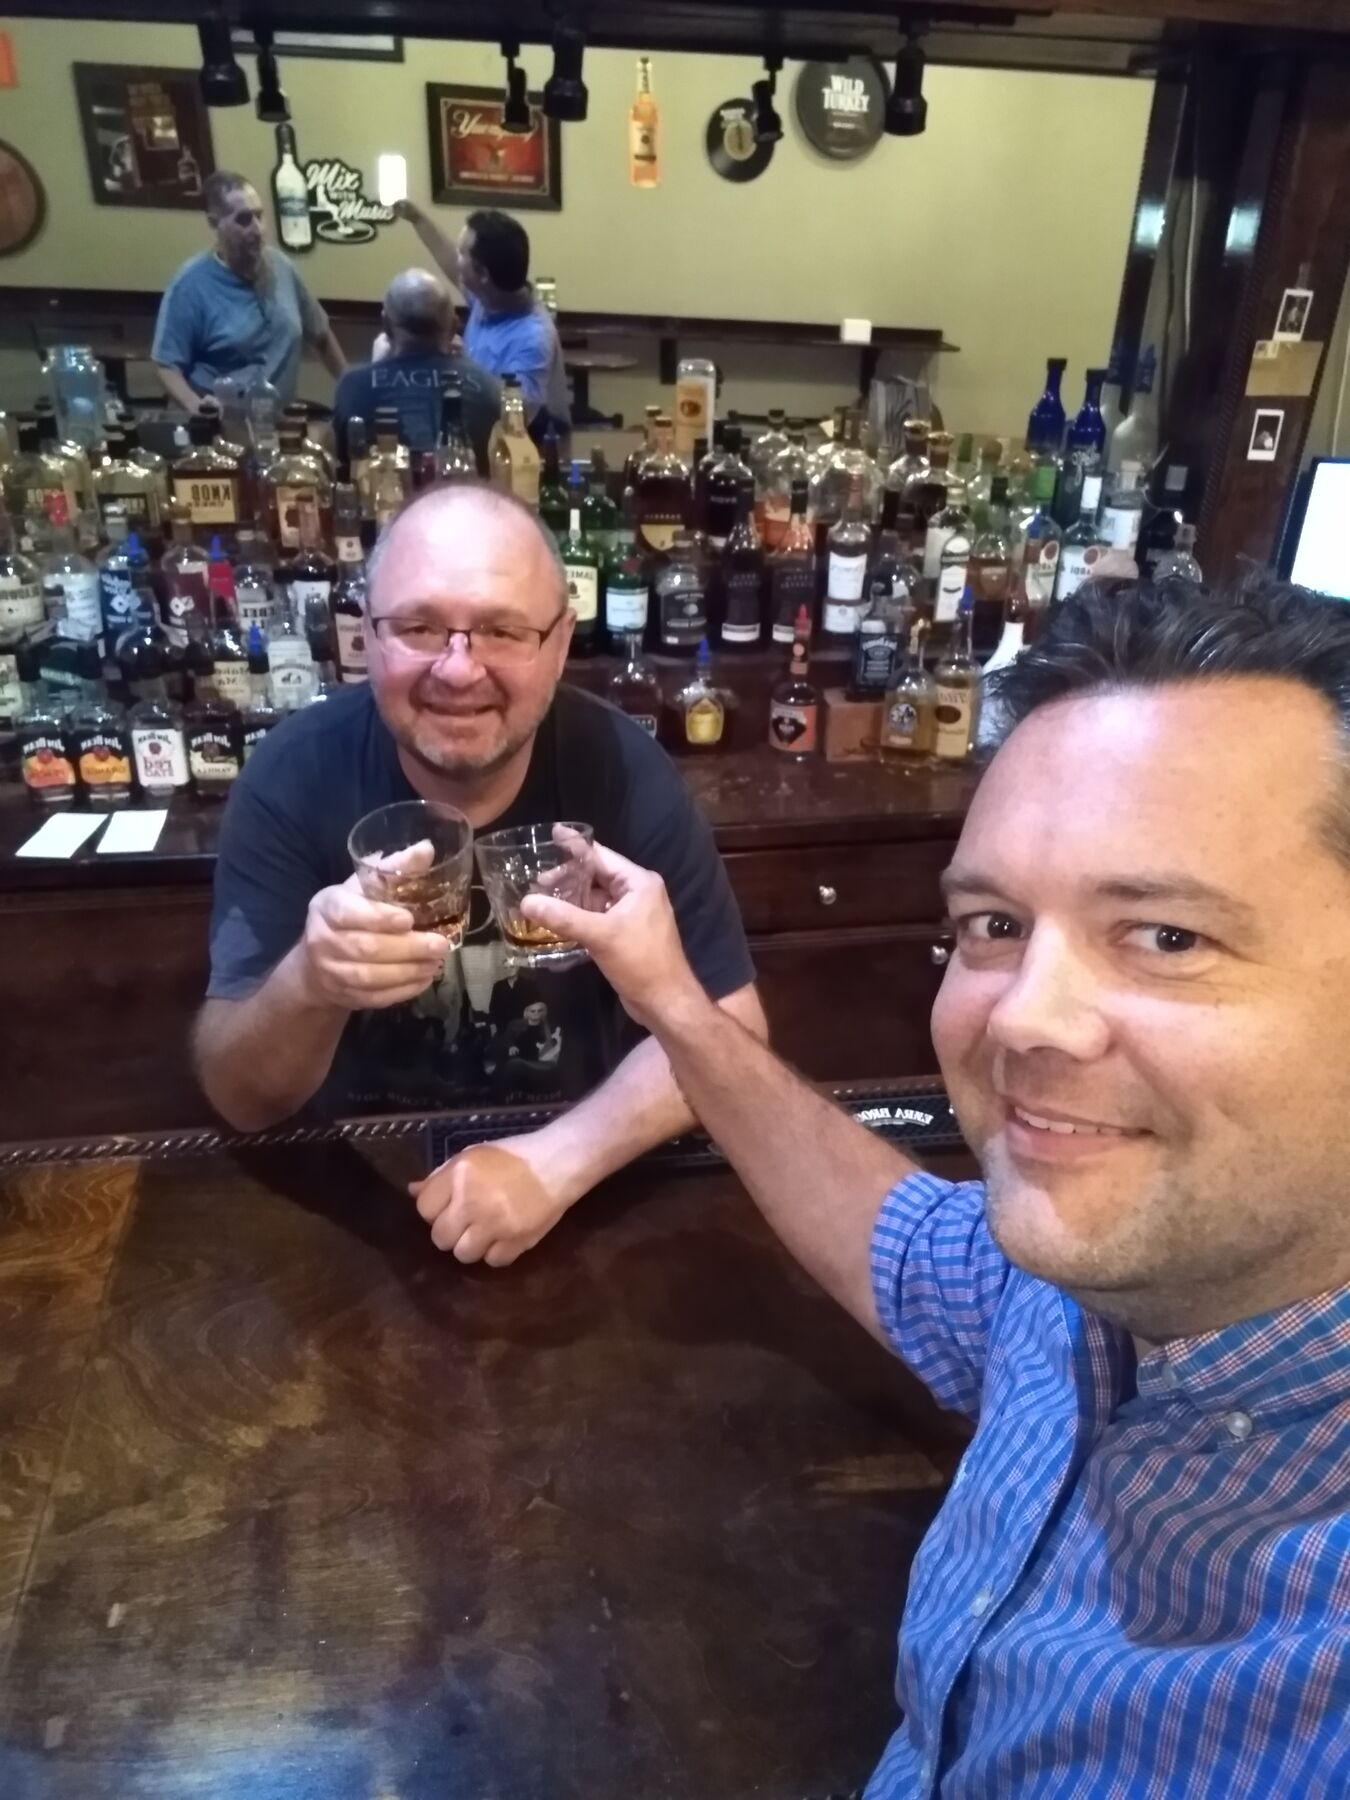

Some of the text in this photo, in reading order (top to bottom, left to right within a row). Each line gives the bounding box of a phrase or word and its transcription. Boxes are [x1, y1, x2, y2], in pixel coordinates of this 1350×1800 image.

[830, 75, 865, 94] WILD
[822, 88, 870, 113] TURKEY
[306, 163, 360, 191] Mix
[371, 368, 481, 392] EAGLS
